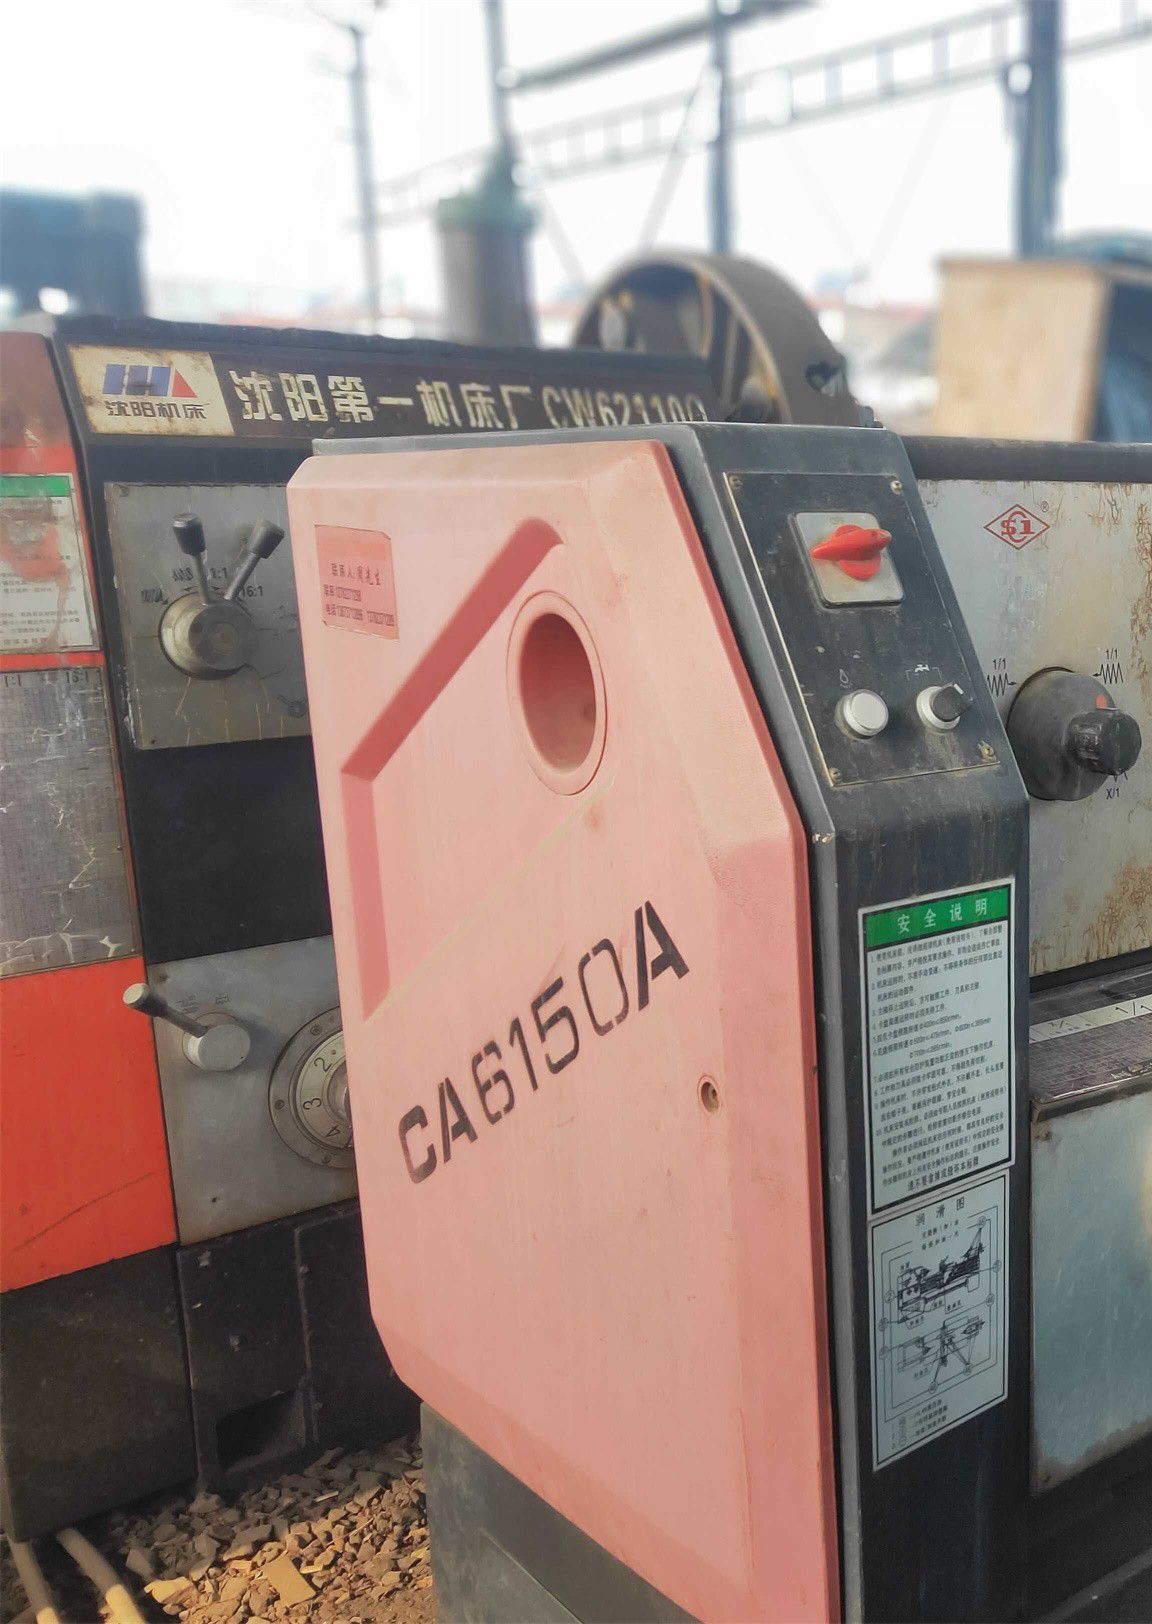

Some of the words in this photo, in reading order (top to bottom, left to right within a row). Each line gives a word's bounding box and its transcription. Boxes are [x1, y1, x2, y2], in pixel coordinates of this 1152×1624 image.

[105, 401, 210, 419] 沈阳机床
[229, 370, 531, 429] 沈阳第一机床厂
[897, 897, 988, 934] 安全说明
[398, 900, 690, 1184] CA6150A
